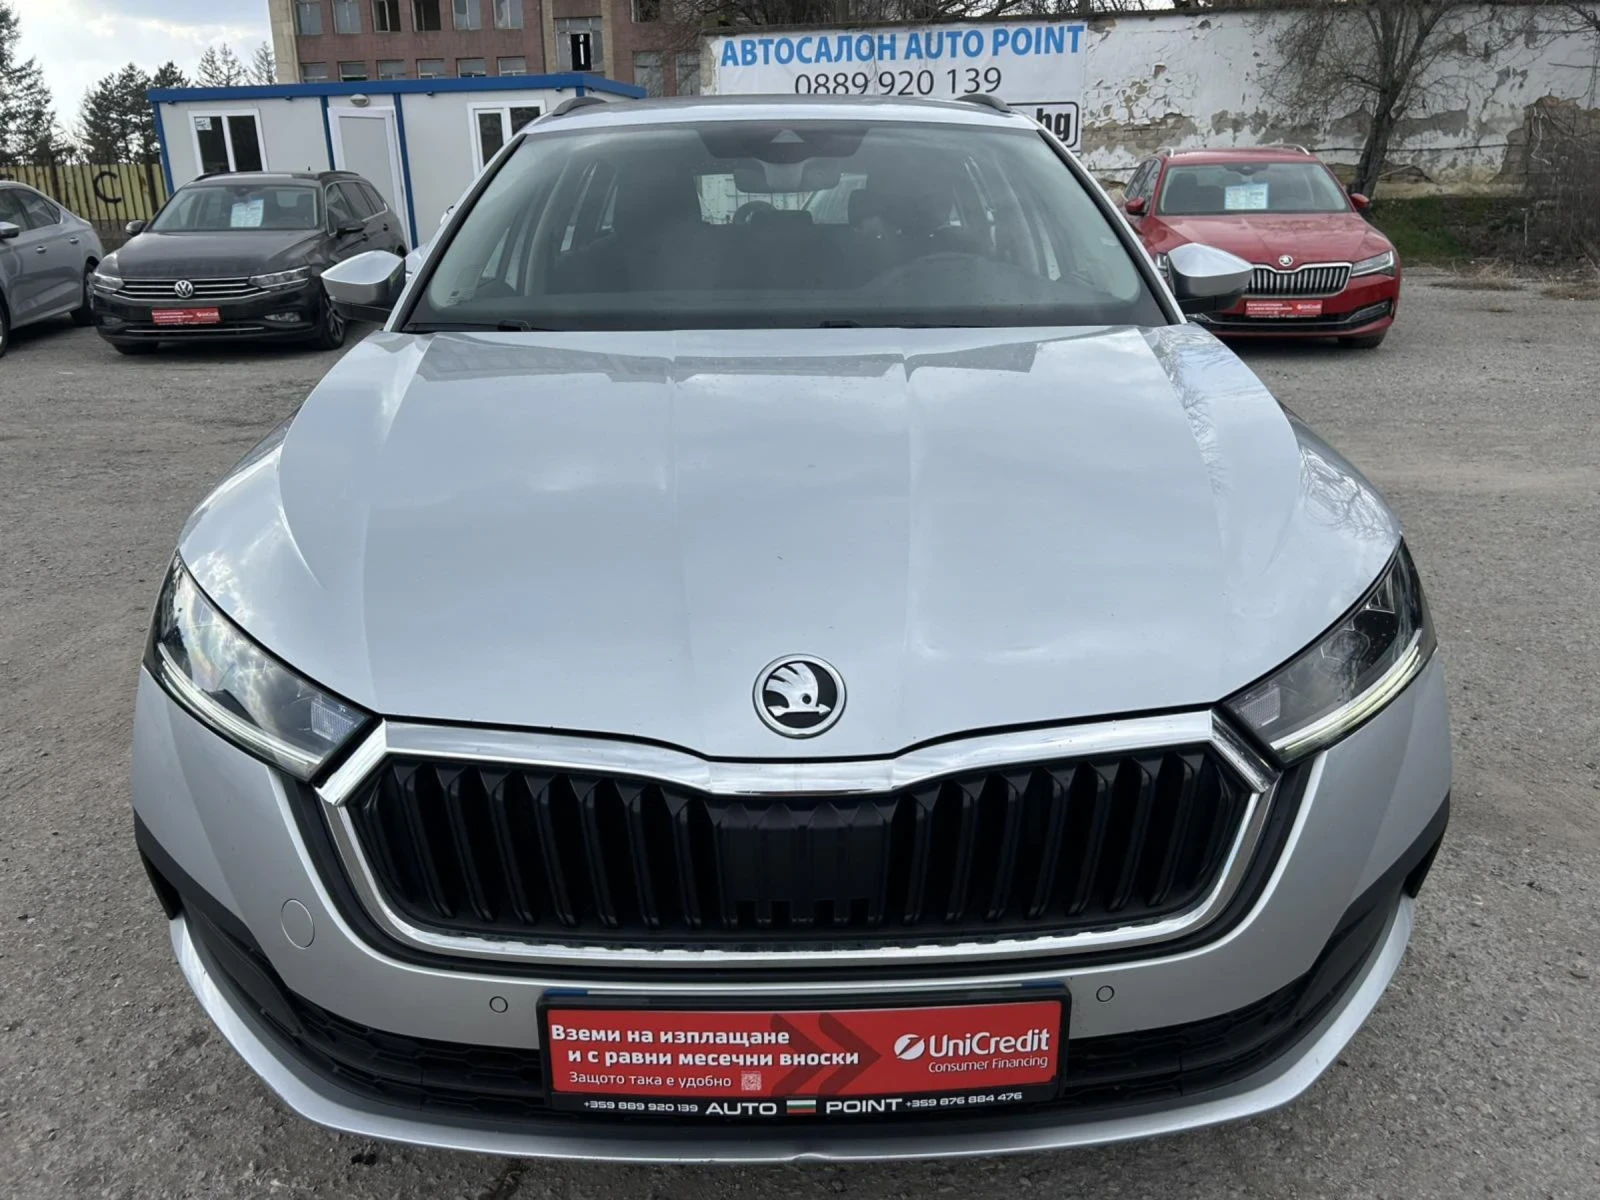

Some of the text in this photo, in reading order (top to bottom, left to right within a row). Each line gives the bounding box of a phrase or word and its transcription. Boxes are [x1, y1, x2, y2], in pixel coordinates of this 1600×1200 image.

[721, 25, 1085, 67] АВТОСАЛОН AUTO POINT
[795, 67, 1002, 96] 0889 920 139
[551, 1025, 790, 1047] Вземи на изплащане
[929, 1028, 1050, 1057] UniCredit
[568, 1049, 859, 1067] и с равни месечни вноски
[928, 1056, 1048, 1073] Consumer Financing
[569, 1071, 732, 1089] Защото така е удобно
[584, 1100, 615, 1109] +359
[618, 1101, 645, 1110] 889
[648, 1103, 675, 1112] 920
[677, 1104, 699, 1112] 139
[705, 1102, 777, 1115] AUTO
[826, 1098, 902, 1114] POINT
[906, 1098, 937, 1108] +359
[997, 1091, 1022, 1101] 476
